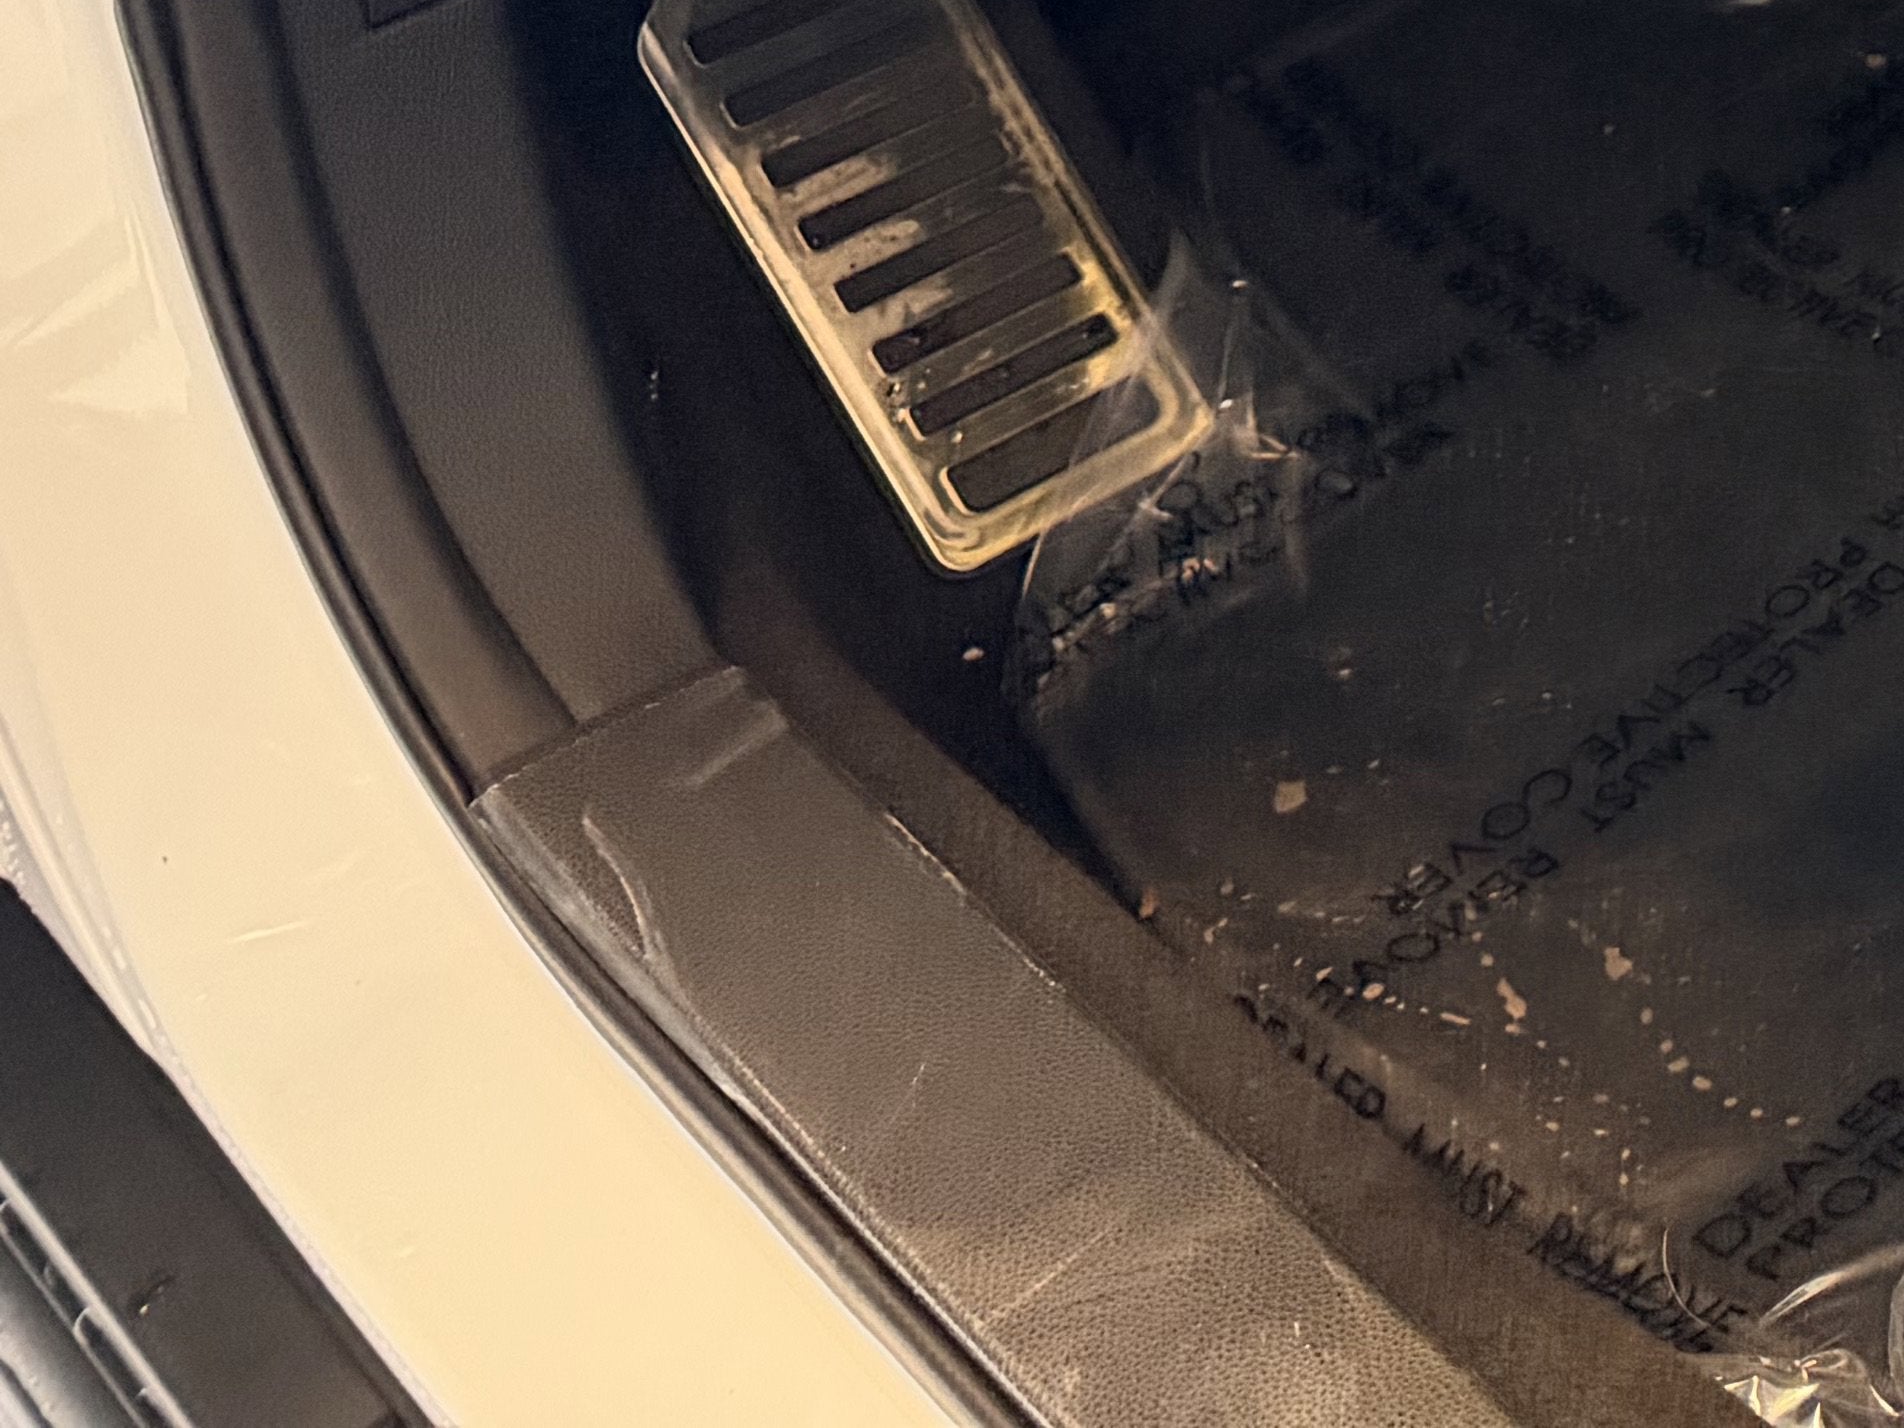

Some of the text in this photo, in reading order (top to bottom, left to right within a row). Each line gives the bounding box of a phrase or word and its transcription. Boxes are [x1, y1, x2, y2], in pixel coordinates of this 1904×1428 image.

[1372, 534, 1866, 916] PROTECTIVE COVER
[1583, 718, 1712, 834] MUST
[1305, 844, 1560, 1007] REMOVE
